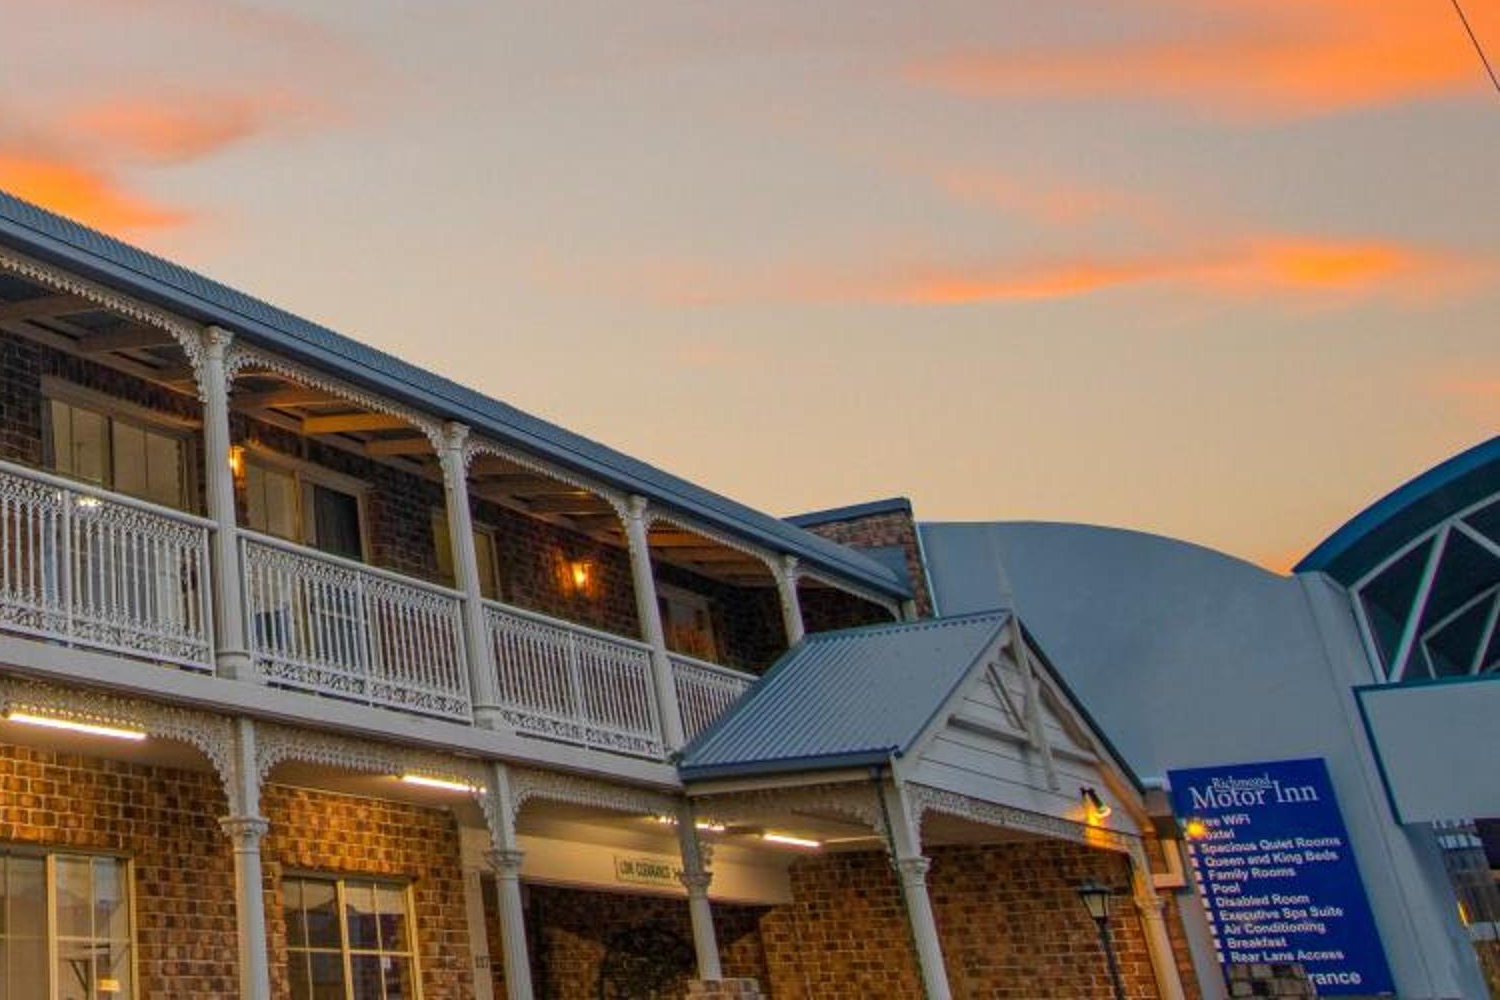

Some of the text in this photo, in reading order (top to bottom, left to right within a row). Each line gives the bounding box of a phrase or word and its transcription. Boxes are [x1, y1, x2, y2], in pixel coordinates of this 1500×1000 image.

[1212, 772, 1273, 790] Richmond
[1188, 780, 1319, 809] Motor Inn
[1197, 828, 1236, 841] oxtel
[1201, 836, 1341, 855] Spacious Quiet Rooms
[1205, 850, 1339, 868] Queen and King Beds
[1208, 866, 1296, 882] Family Rooms
[1212, 883, 1241, 894] Pool
[1215, 893, 1310, 907] Disabled Room
[1219, 905, 1344, 921] Executive Spa Suite
[1224, 921, 1327, 935] Air Conditioning
[1227, 937, 1288, 948] Breakfast
[1231, 949, 1345, 962] Rear Lane Access
